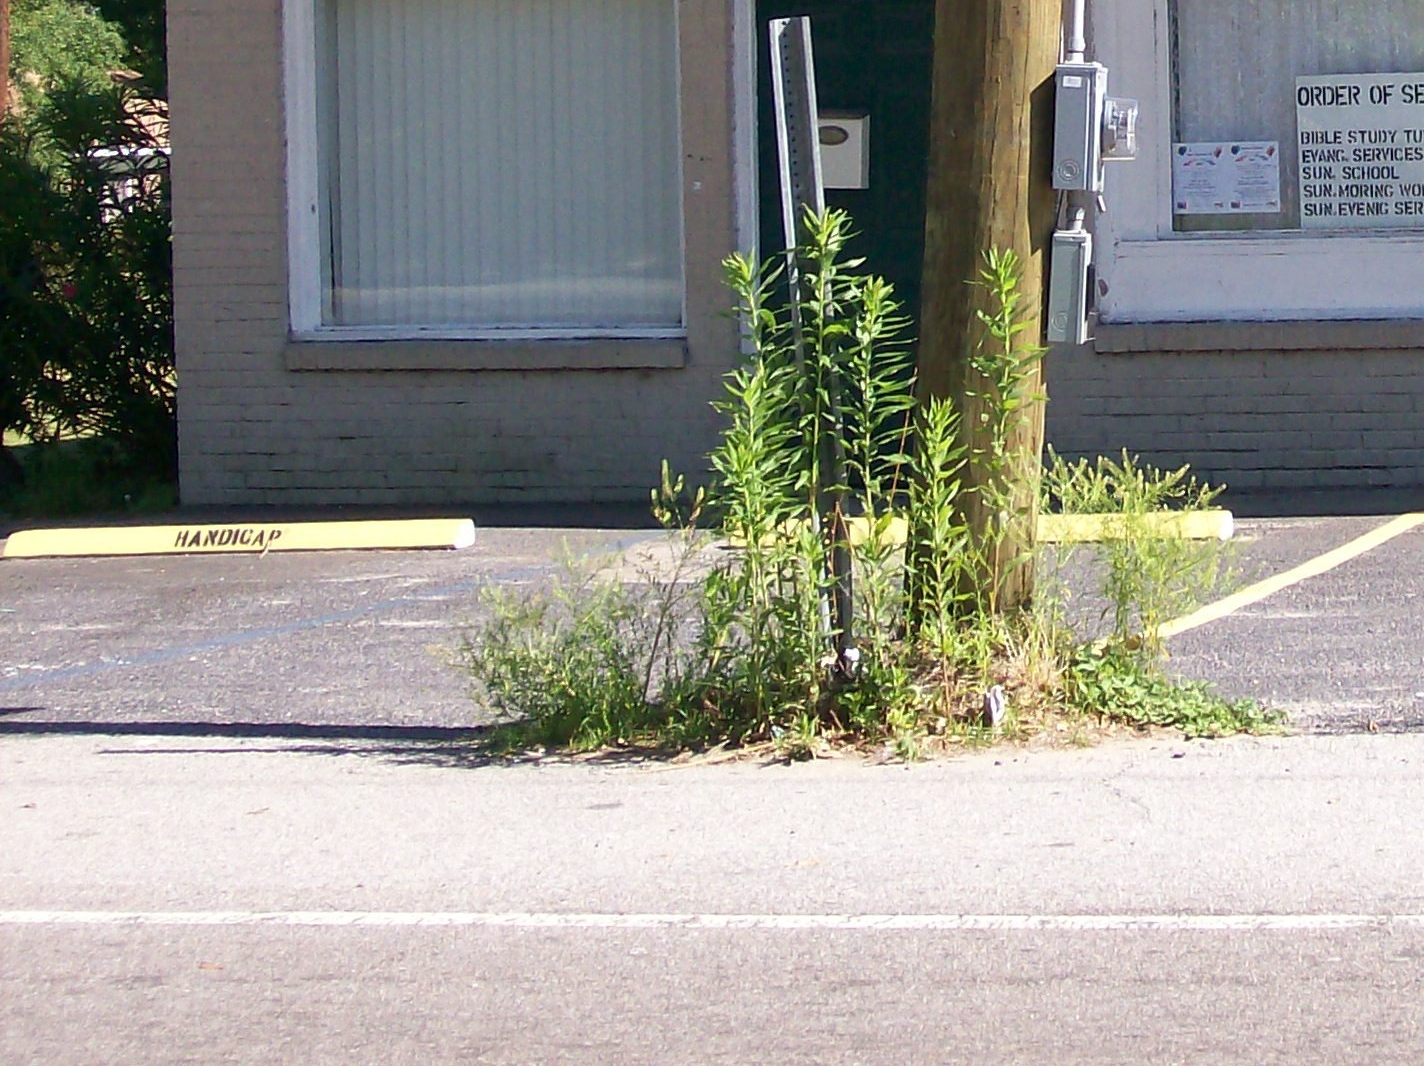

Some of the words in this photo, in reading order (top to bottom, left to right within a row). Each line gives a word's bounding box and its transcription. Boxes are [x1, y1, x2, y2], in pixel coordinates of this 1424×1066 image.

[1297, 85, 1360, 106] ORDER
[1369, 84, 1394, 105] OF
[1300, 131, 1342, 145] BIBLE
[1347, 130, 1397, 144] STUDY
[1352, 147, 1424, 162] SERVICES
[1342, 166, 1400, 179] SCHOOL
[175, 529, 282, 547] HANDICAP
